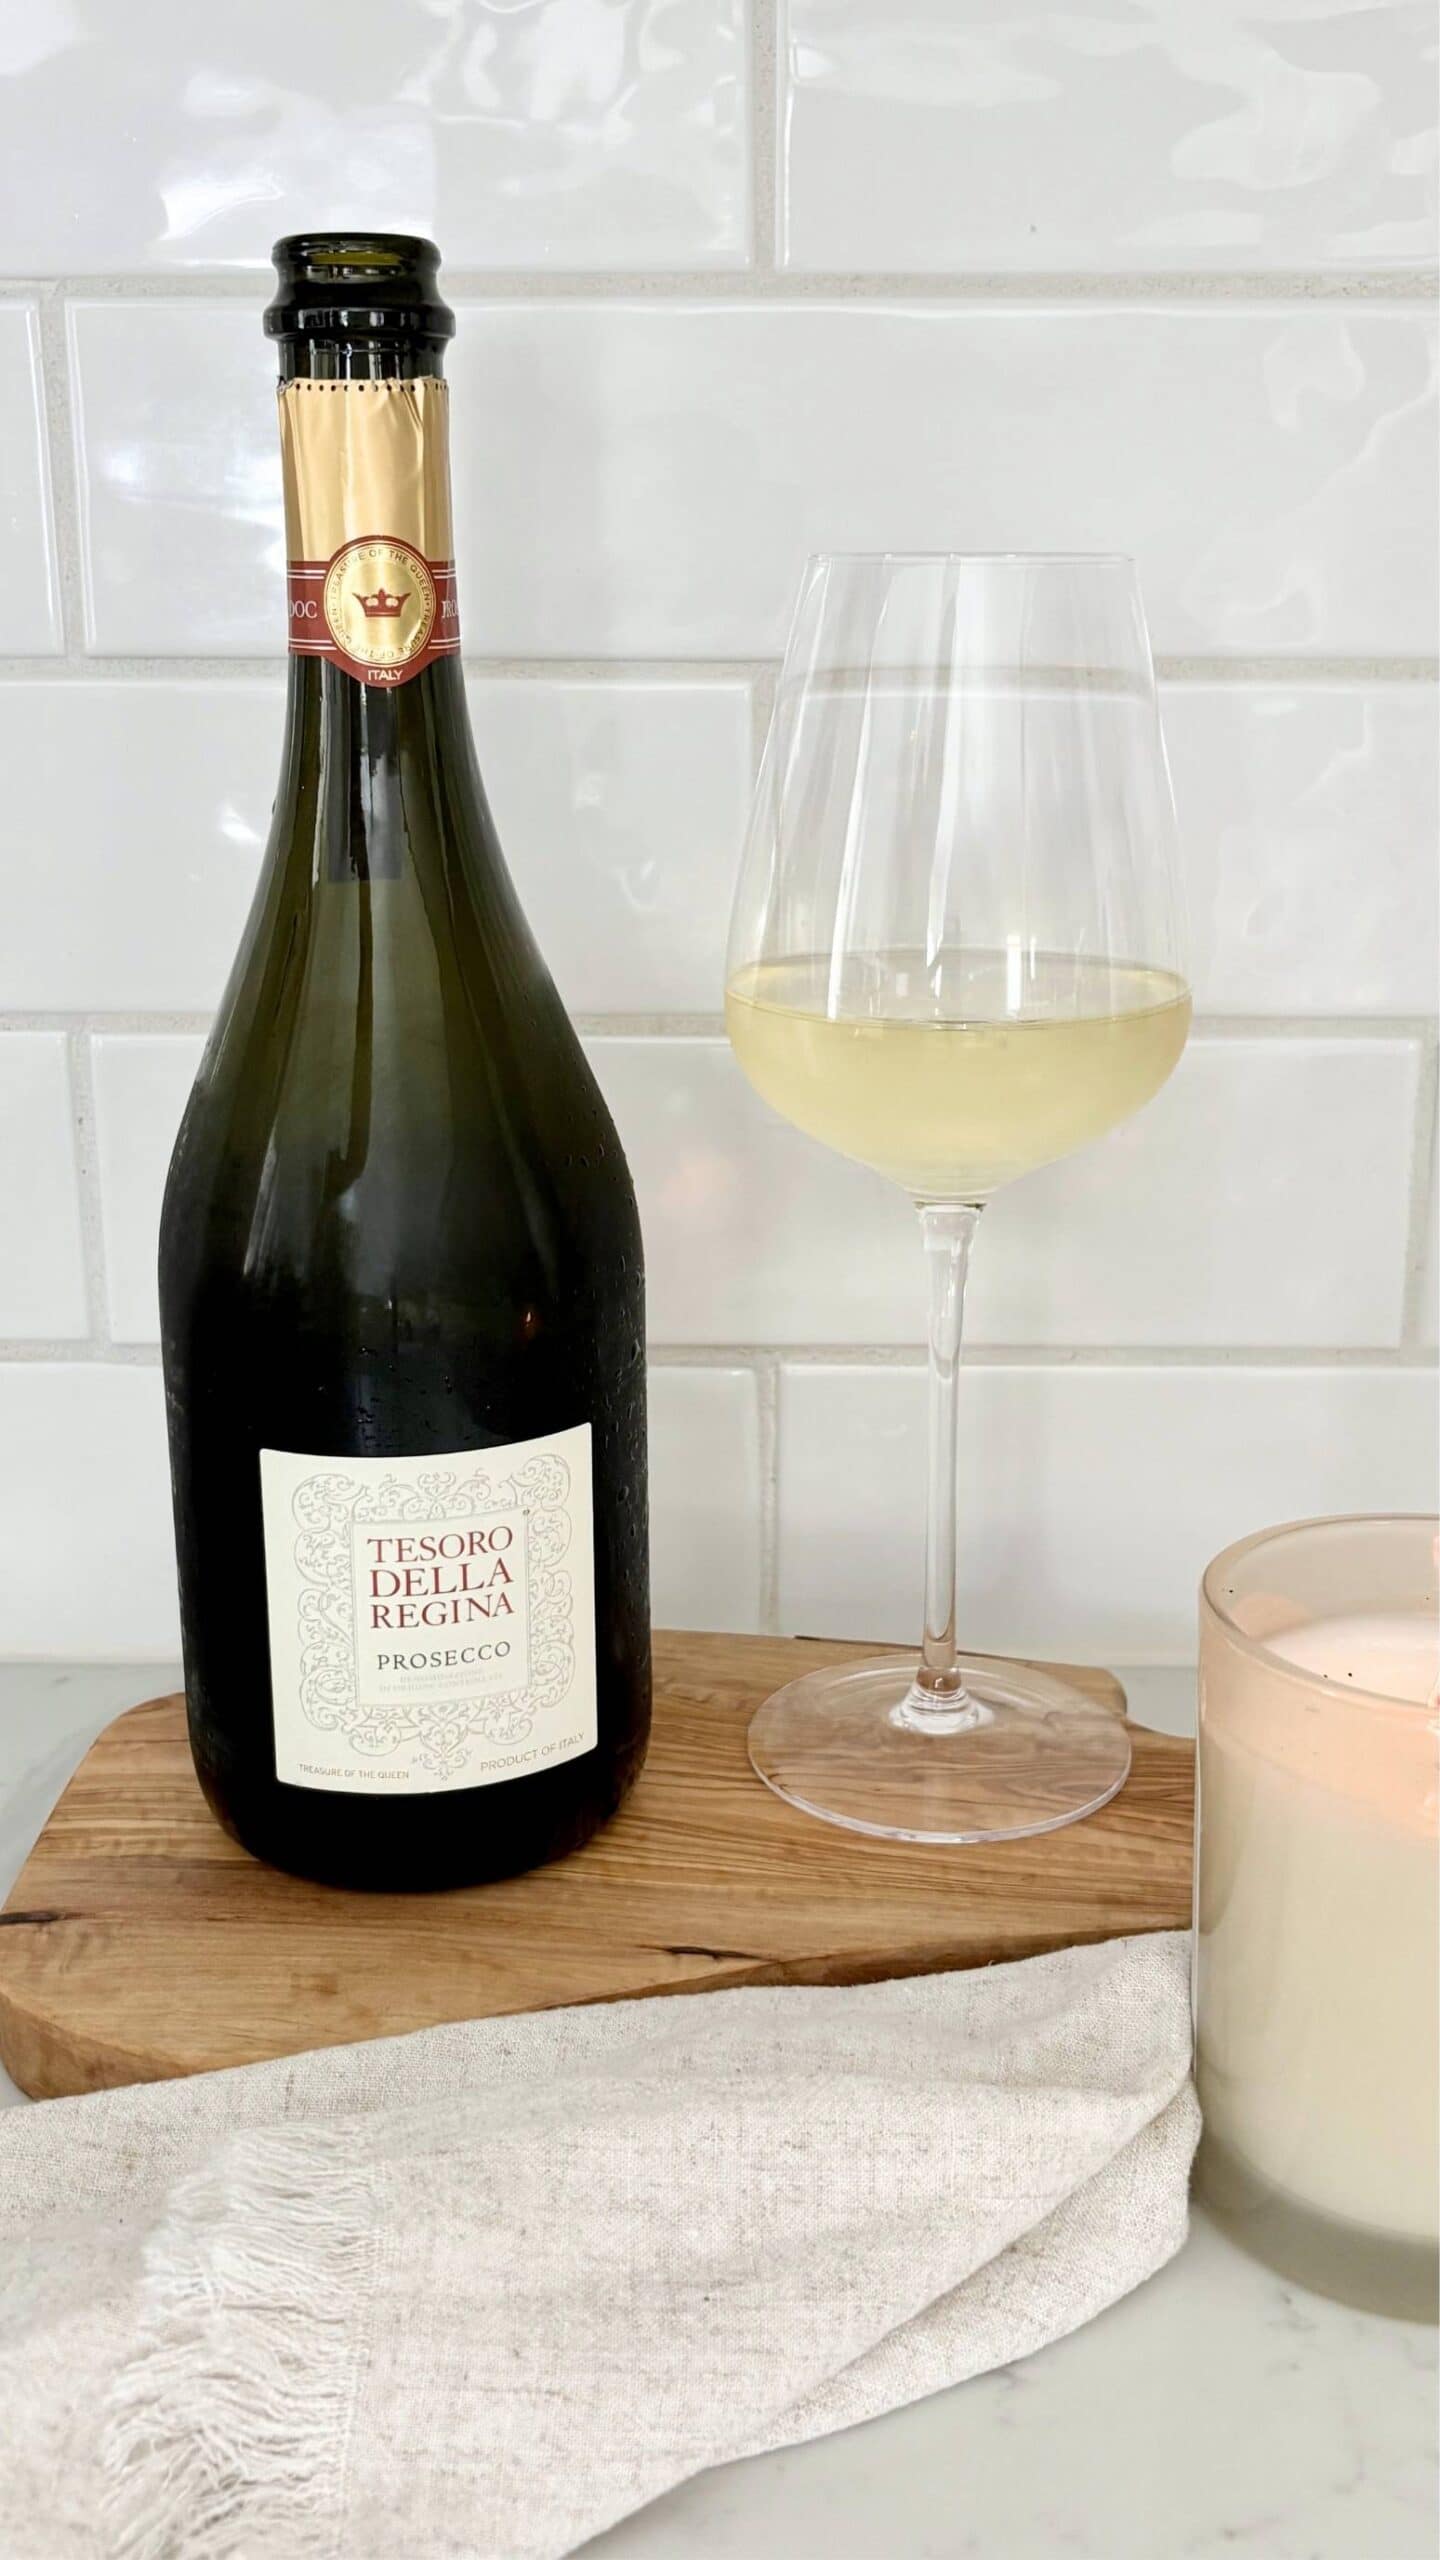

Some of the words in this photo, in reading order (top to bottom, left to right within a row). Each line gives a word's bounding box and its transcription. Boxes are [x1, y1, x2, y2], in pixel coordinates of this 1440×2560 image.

[388, 550, 408, 565] THE
[409, 563, 431, 602] QUEEN
[367, 669, 403, 681] ITALY
[367, 1526, 513, 1563] TESORO
[369, 1557, 514, 1598] DELLA
[370, 1592, 515, 1629] REGINA
[377, 1641, 511, 1670] PROSECCO
[480, 1749, 538, 1772] PRODUCT
[541, 1744, 557, 1757] OF
[558, 1732, 585, 1751] ITALY
[298, 1763, 343, 1777] TREASURE
[344, 1768, 356, 1777] OF
[358, 1769, 376, 1779] THE
[377, 1769, 409, 1780] QUEEN
